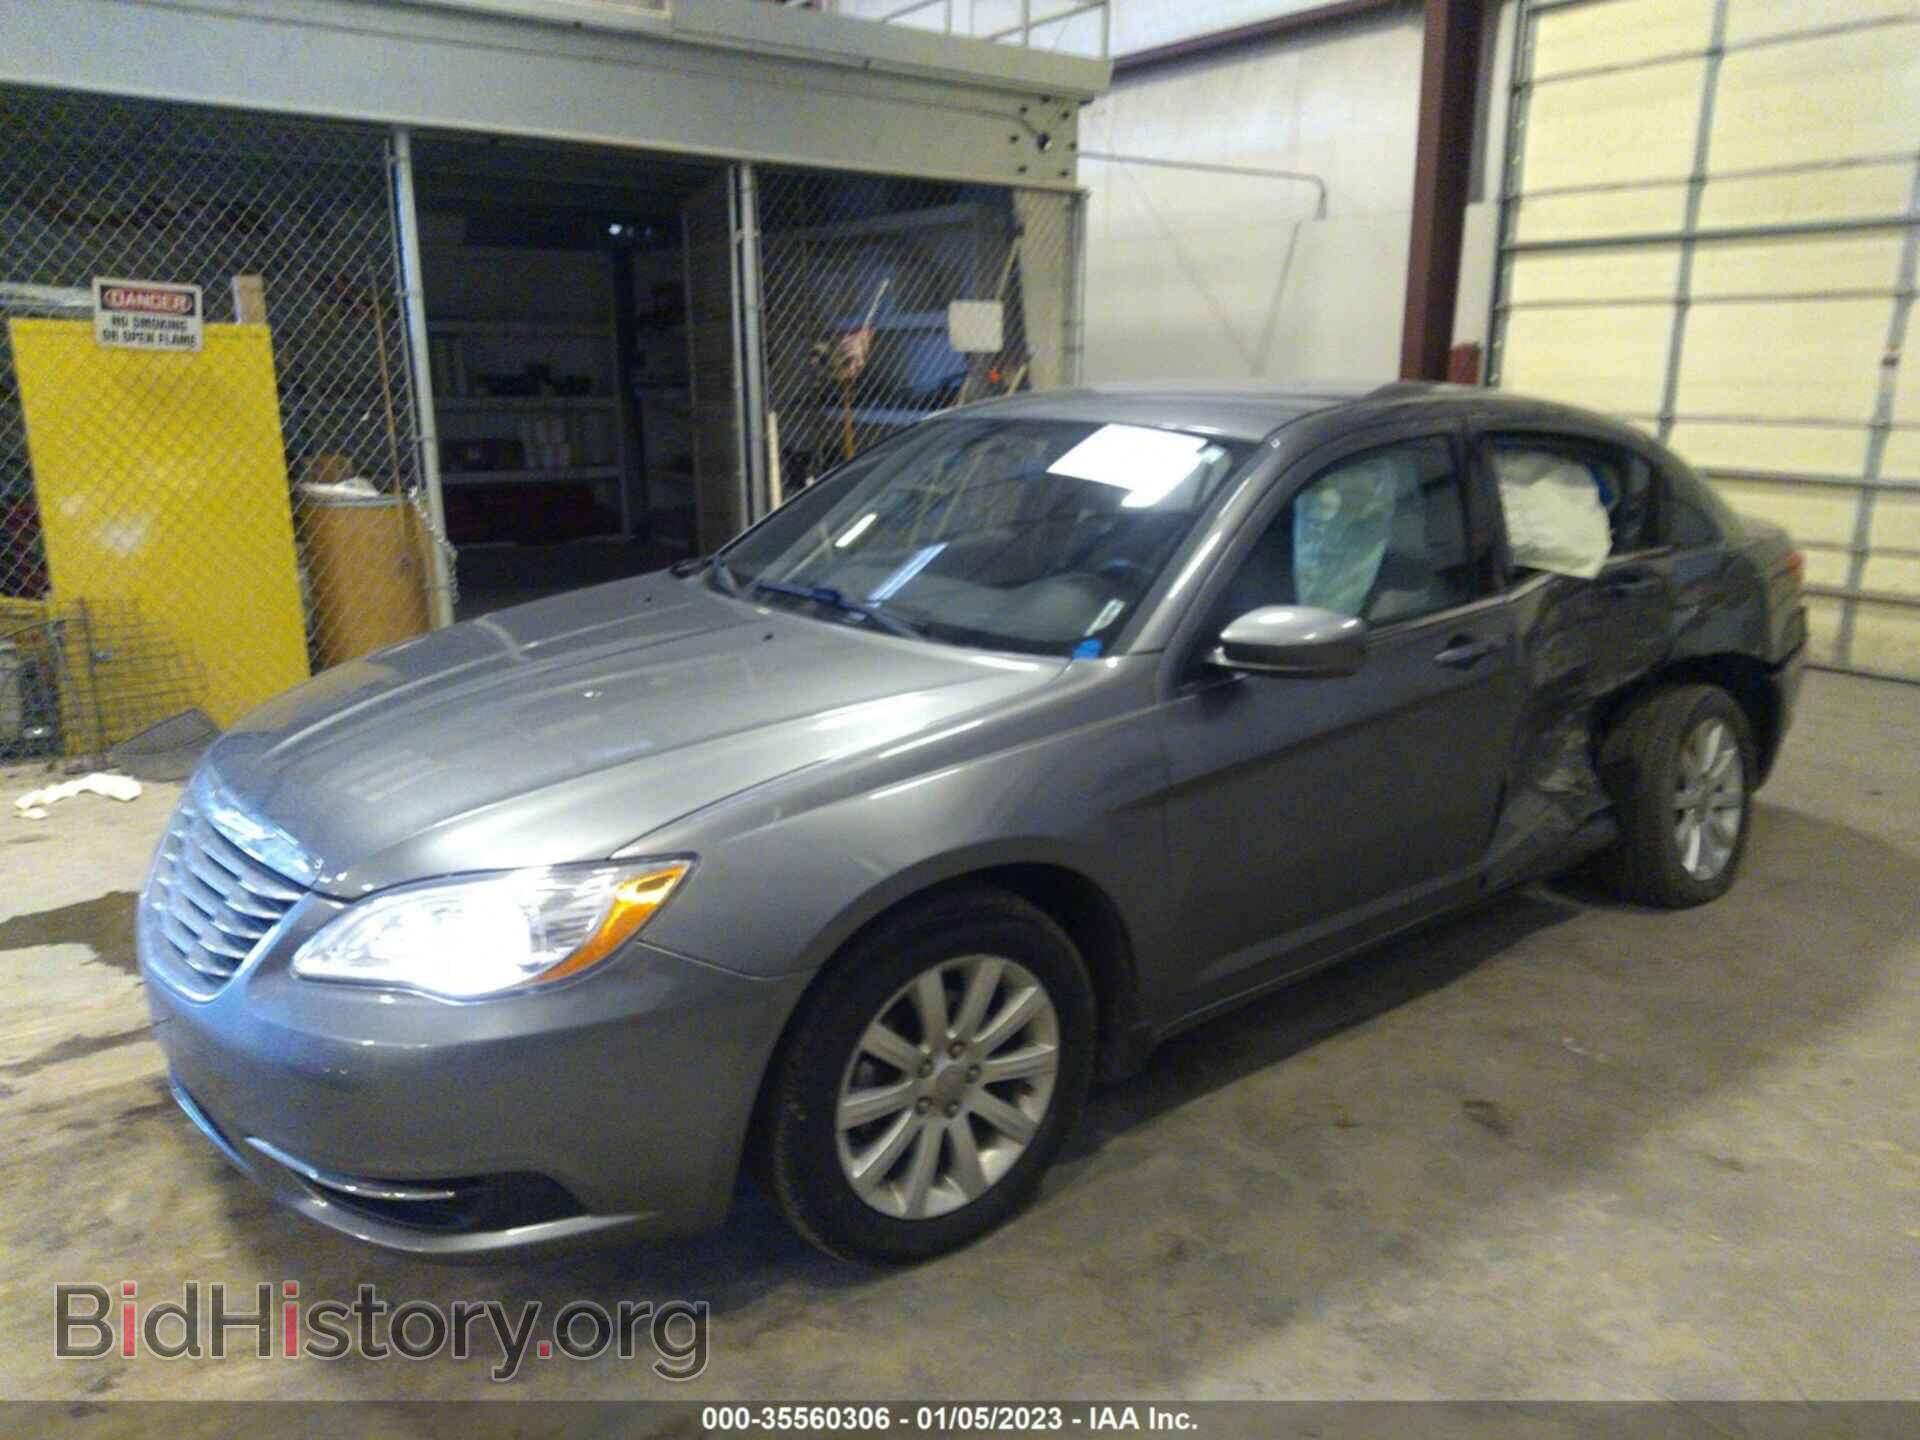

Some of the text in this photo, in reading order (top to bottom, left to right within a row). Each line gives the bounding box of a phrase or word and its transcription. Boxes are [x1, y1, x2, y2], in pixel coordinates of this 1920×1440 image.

[108, 291, 189, 312] DANGER
[111, 316, 189, 333] NO SMOKING
